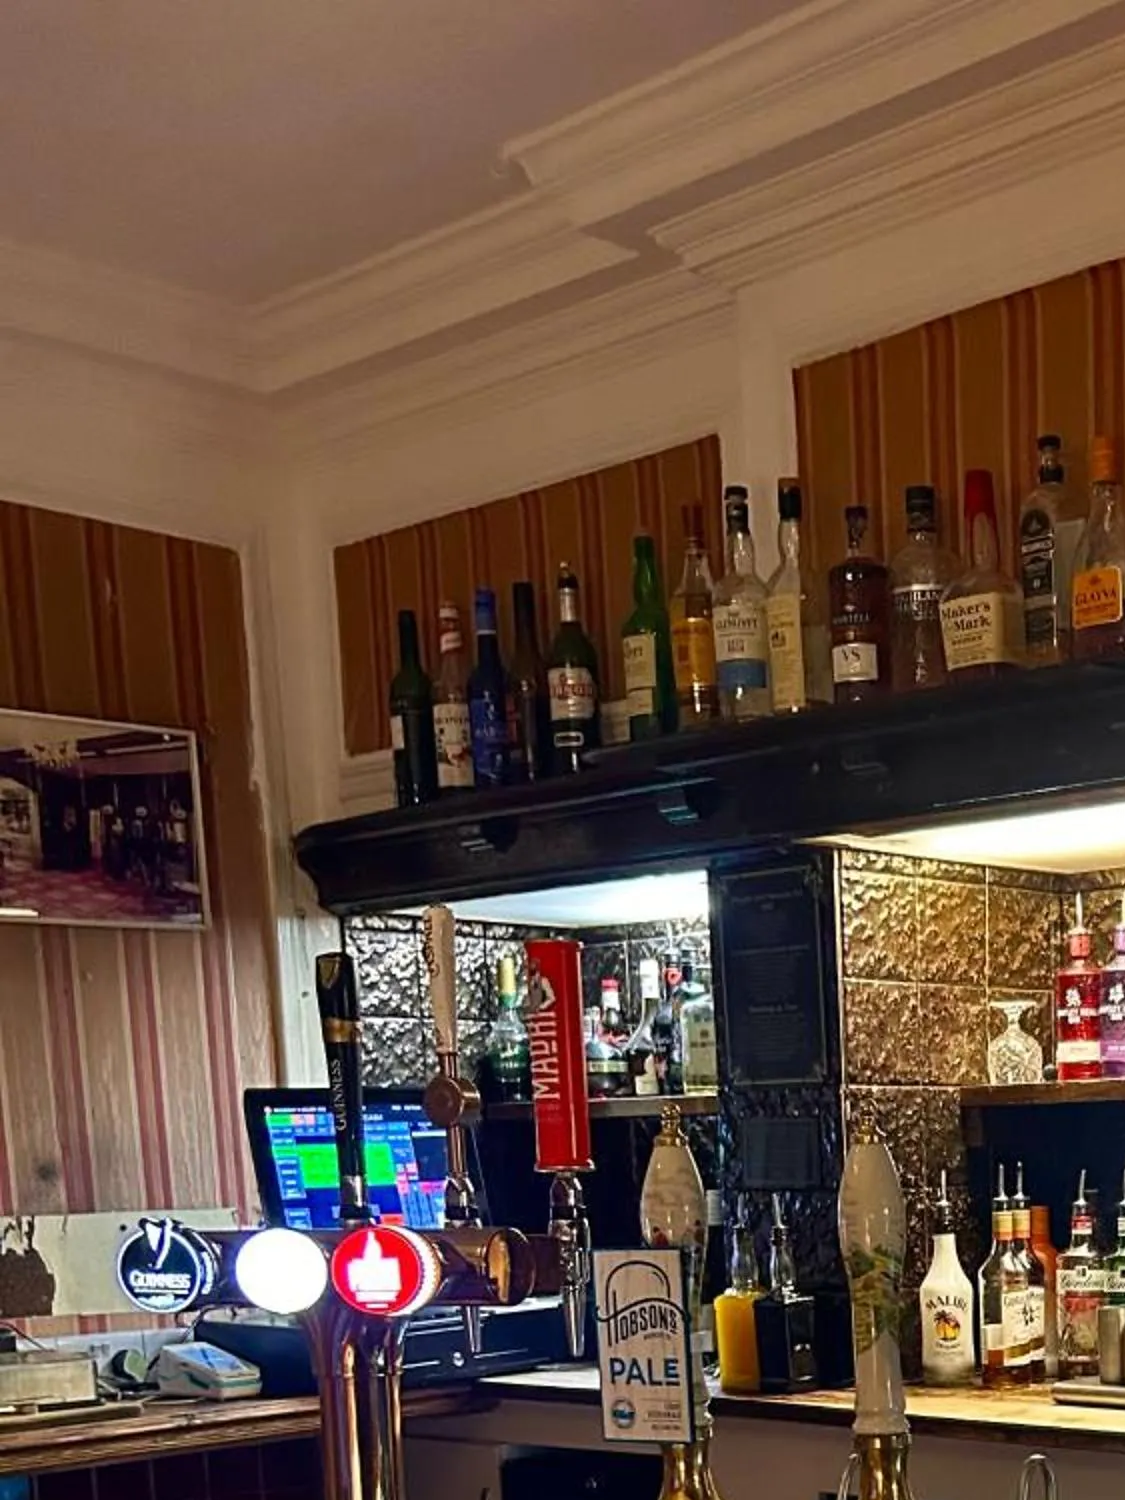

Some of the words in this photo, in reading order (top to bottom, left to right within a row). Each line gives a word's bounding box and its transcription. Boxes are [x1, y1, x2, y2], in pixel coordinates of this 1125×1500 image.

[941, 601, 991, 620] Maker's
[953, 616, 992, 631] Mark
[331, 1059, 347, 1131] GUINNESS
[129, 1269, 191, 1290] GUINNESS
[925, 1295, 968, 1311] MALIBU
[606, 1290, 678, 1348] HOBSONS
[609, 1357, 681, 1387] PALE
